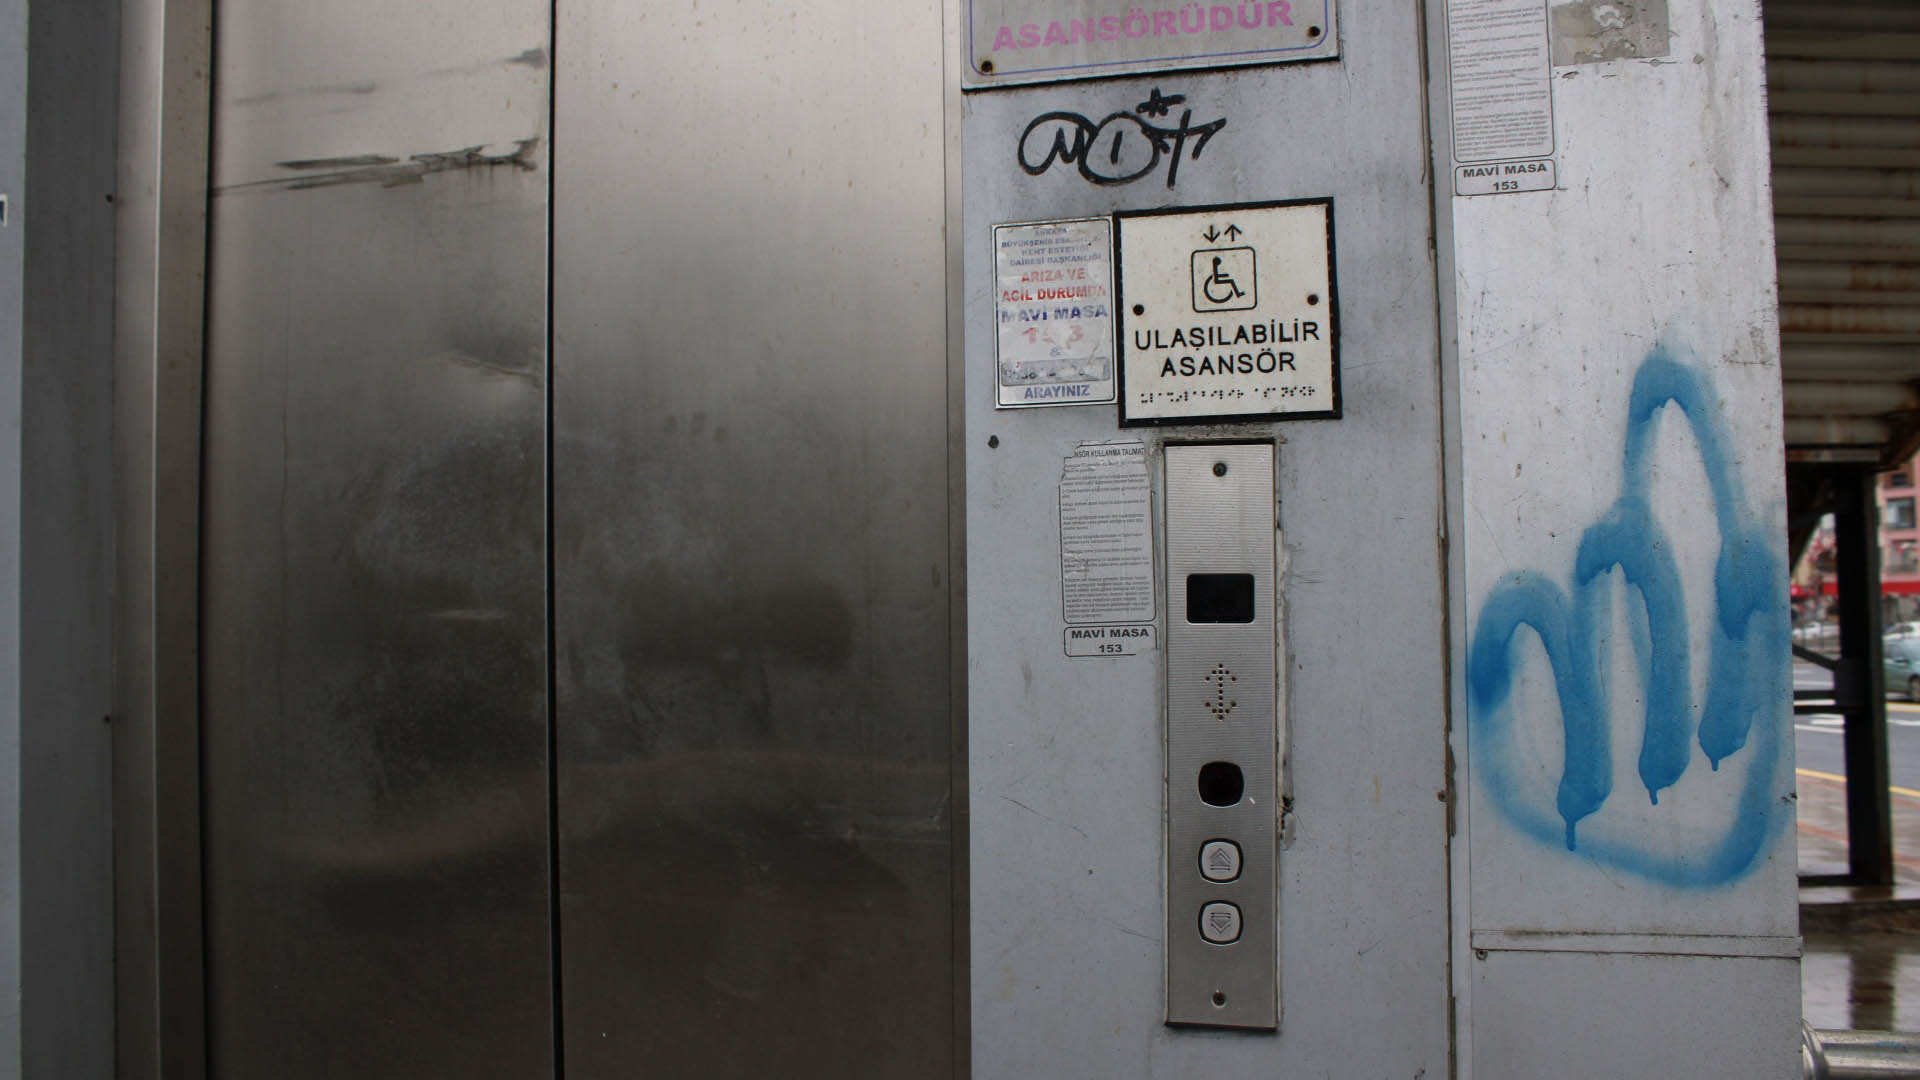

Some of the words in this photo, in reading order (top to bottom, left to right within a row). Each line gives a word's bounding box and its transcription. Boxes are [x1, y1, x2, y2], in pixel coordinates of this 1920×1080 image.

[992, 0, 1294, 52] ASANSÖRÜDÜR
[1463, 164, 1500, 178] MAVİ
[1505, 162, 1547, 176] MASA
[1493, 180, 1519, 191] 153
[1021, 270, 1064, 283] ARIZA
[1066, 268, 1086, 280] VE
[1002, 286, 1032, 302] ACİL
[1037, 285, 1106, 300] DURUMDA
[1001, 305, 1047, 322] MAVİ
[1054, 304, 1108, 320] MASA
[1135, 318, 1320, 351] ULAŞILABİLİR
[1160, 347, 1296, 377] ASANSÖR
[1024, 385, 1091, 399] ARAYINIZ
[1071, 626, 1105, 639] MAVİ
[1110, 627, 1149, 638] MASA
[1098, 644, 1122, 653] 153
